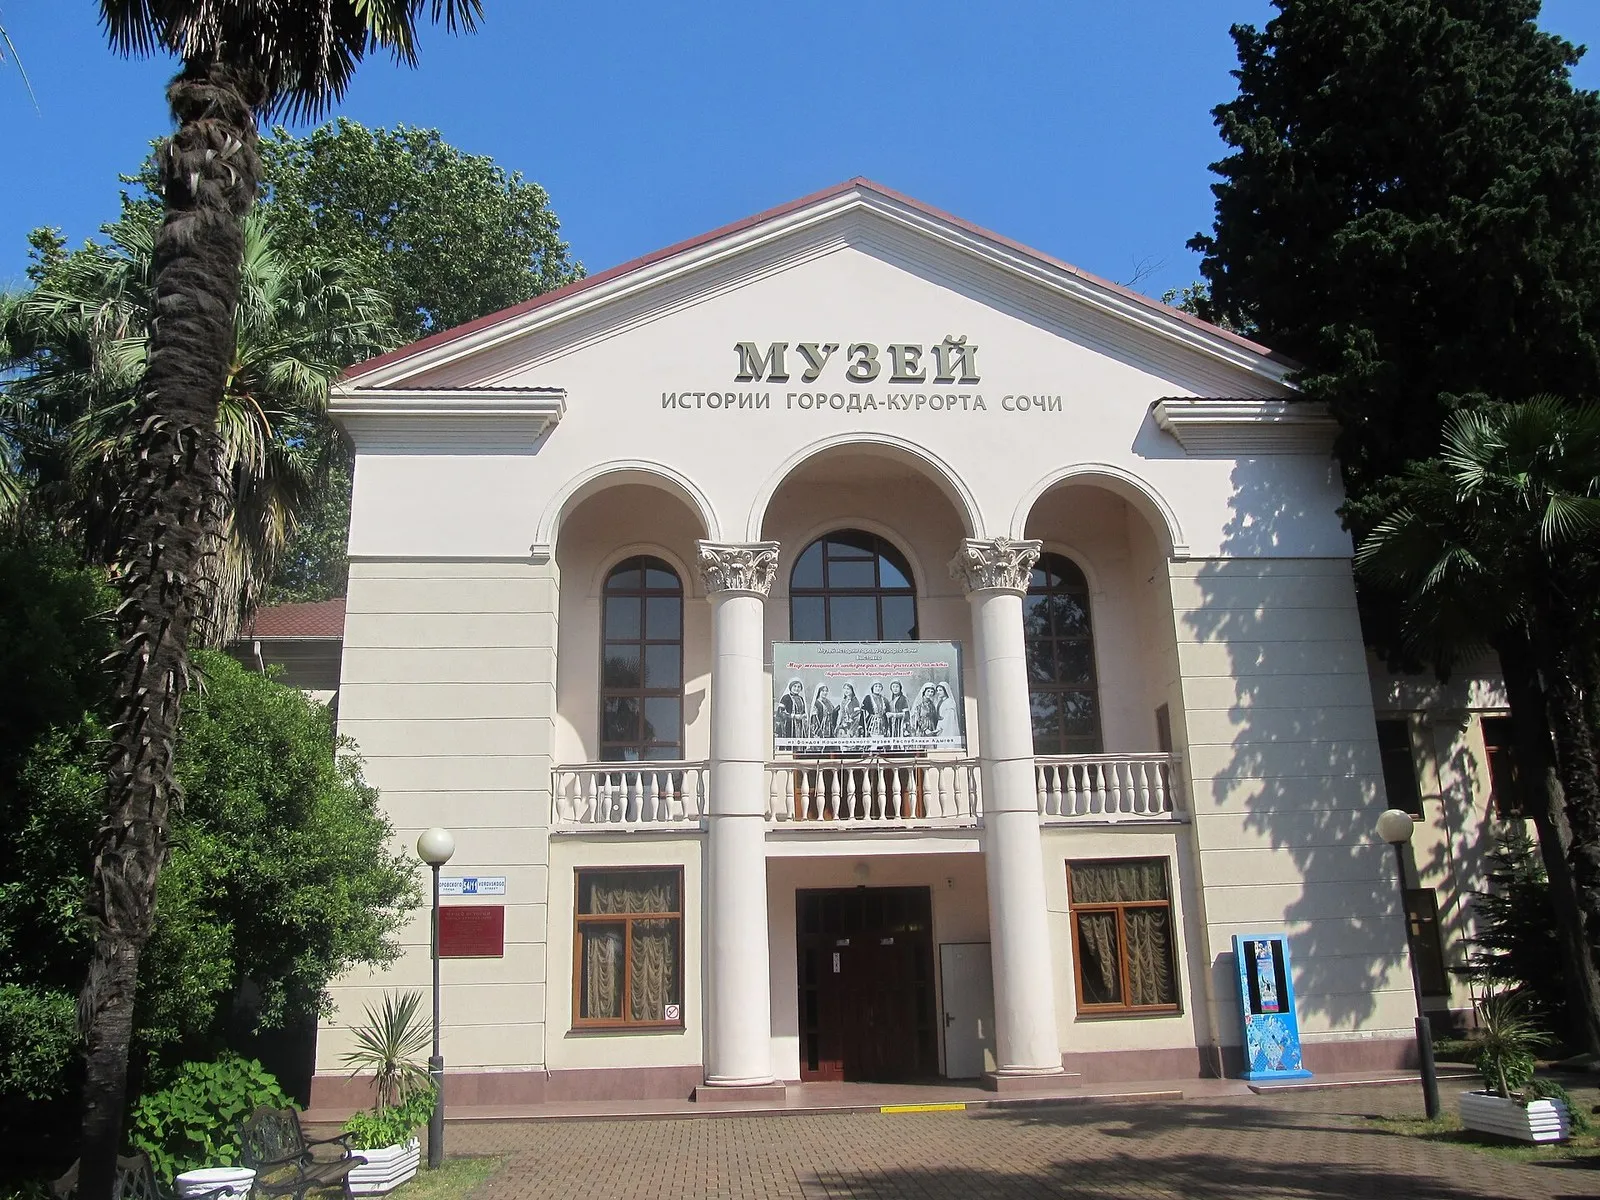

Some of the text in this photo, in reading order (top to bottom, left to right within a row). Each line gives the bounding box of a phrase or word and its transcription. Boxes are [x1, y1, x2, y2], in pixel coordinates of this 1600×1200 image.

[733, 334, 981, 385] МУЗЕЙ
[661, 392, 1064, 413] ИСТОРИИ ГОРОДА-КУРОРТА СОЧИ
